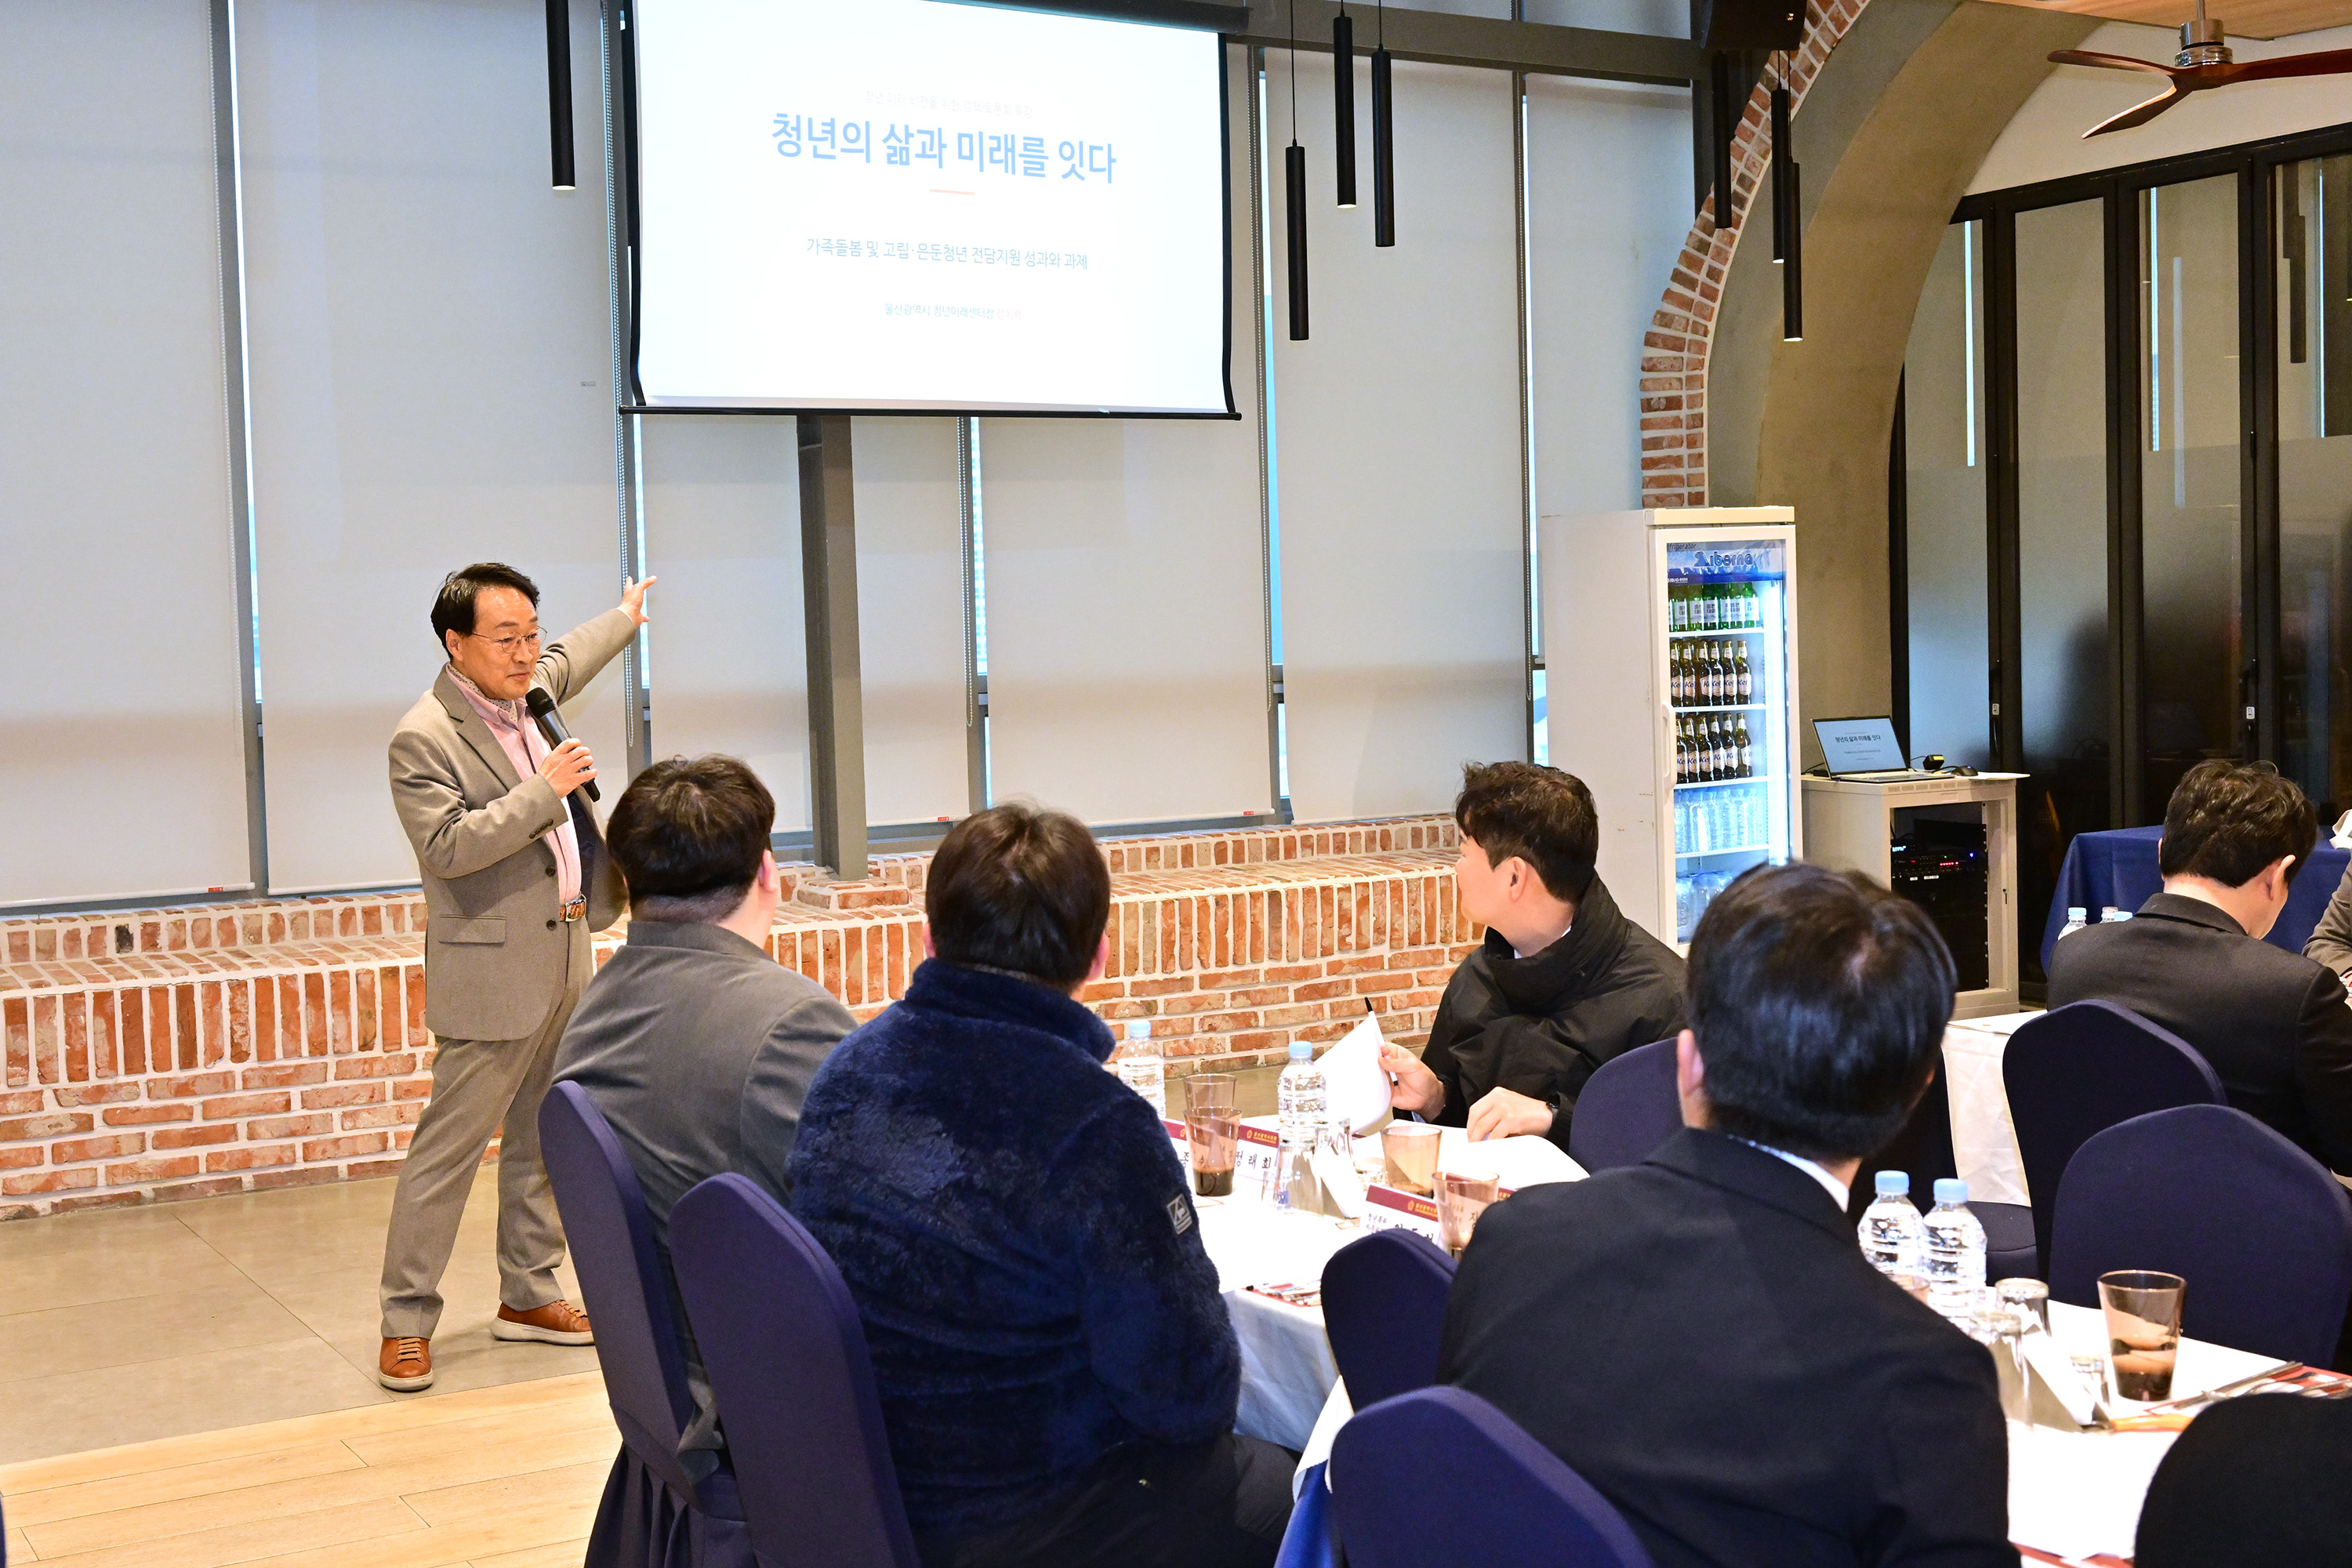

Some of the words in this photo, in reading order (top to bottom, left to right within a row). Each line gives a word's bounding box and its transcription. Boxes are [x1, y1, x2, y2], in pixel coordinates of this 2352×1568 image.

[866, 89, 884, 104] 청년
[887, 92, 906, 107] 미래
[909, 94, 938, 110] 비전을
[942, 97, 960, 111] 위한
[963, 100, 982, 113] 정책
[985, 102, 1011, 116] 토론회
[771, 112, 872, 164] 청년의
[882, 123, 948, 169] 삶과
[956, 131, 1049, 178] 미래를
[1058, 139, 1117, 183] 잇다
[806, 238, 862, 258] 가족돌봄
[866, 240, 879, 258] 및
[971, 246, 1021, 267] 전담지원
[1025, 250, 1062, 269] 성과와
[1064, 252, 1088, 270] 과제
[884, 303, 931, 316] 울산광역시
[933, 304, 994, 320] 청년미래센터장
